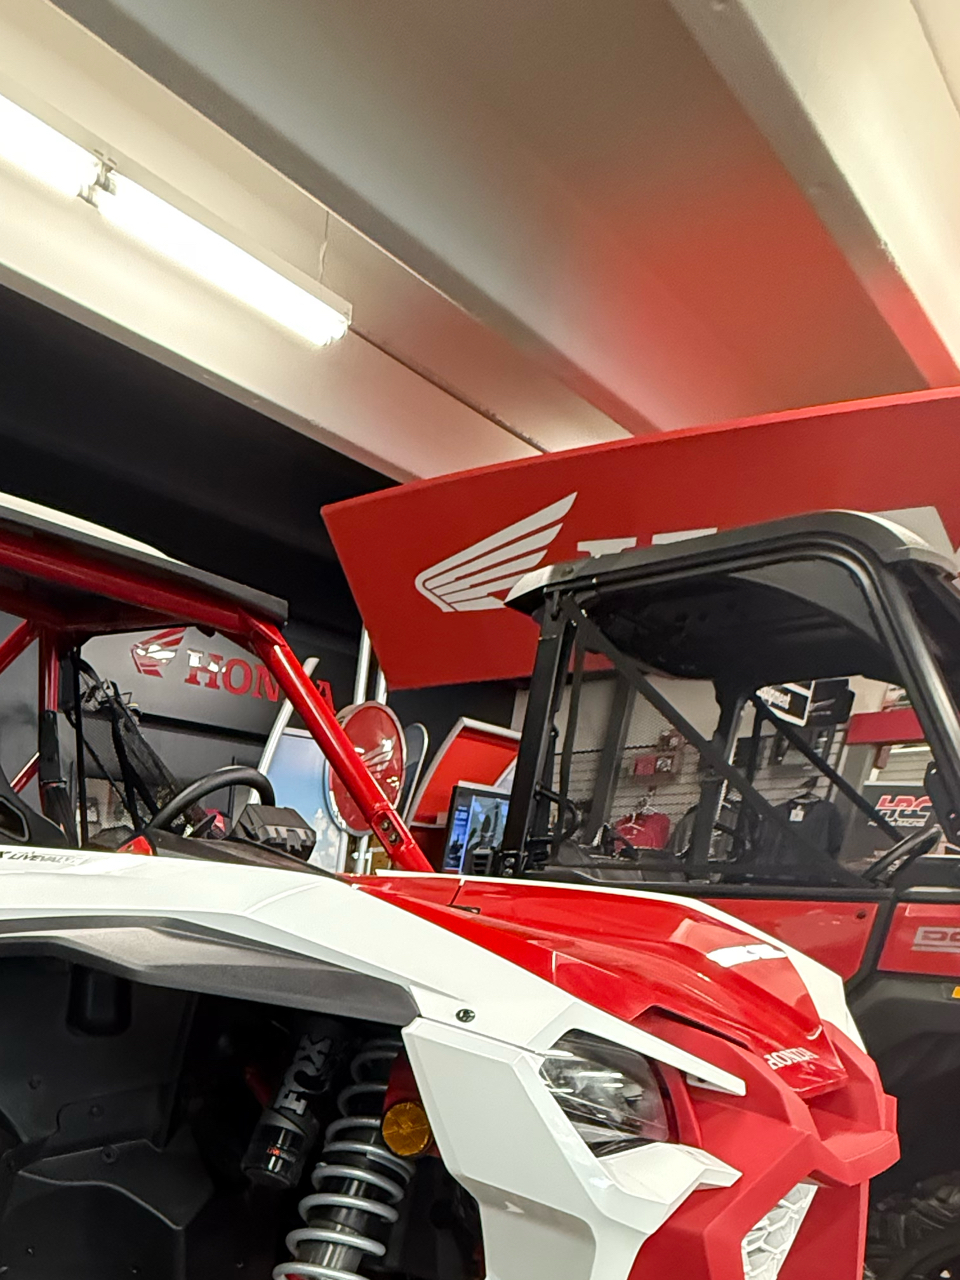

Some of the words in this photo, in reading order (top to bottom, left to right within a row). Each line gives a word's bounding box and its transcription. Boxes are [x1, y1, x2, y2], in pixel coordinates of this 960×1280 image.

[184, 648, 337, 715] HONA
[874, 795, 933, 822] HRC
[273, 1034, 332, 1117] FOX
